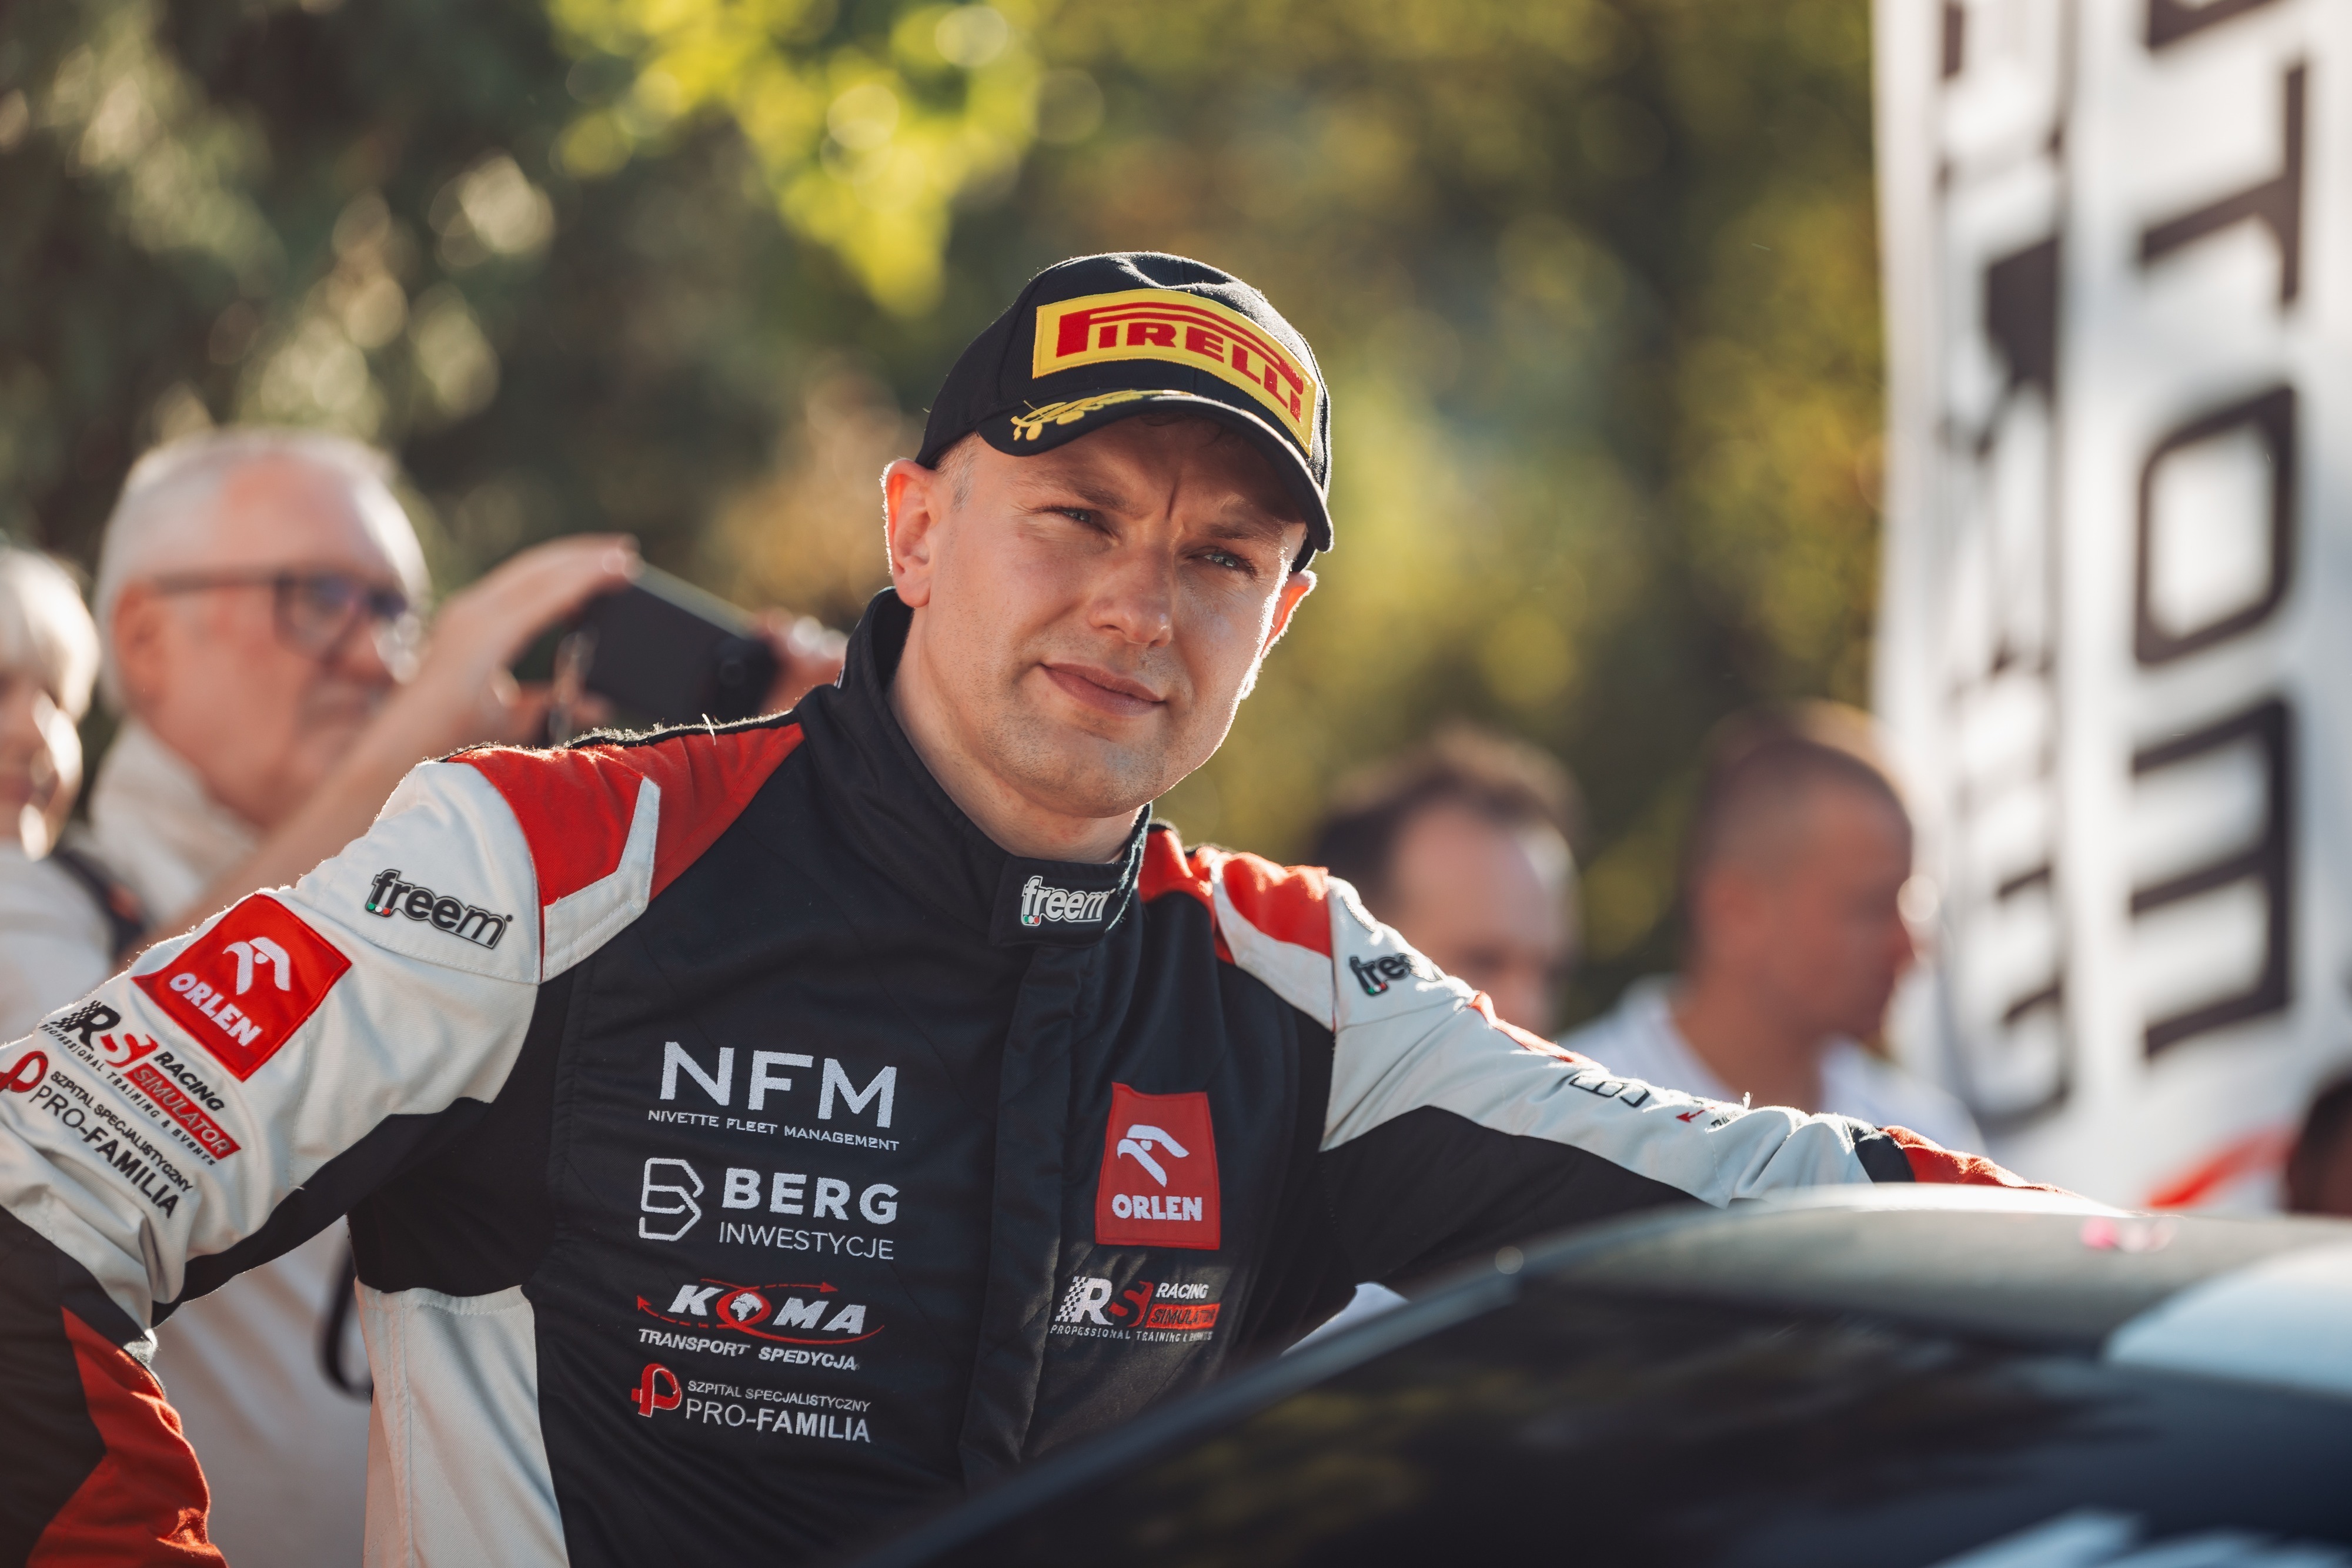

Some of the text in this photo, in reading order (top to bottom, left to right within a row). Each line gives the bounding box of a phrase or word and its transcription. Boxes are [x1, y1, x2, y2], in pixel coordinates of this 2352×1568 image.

[1056, 302, 1304, 423] PIRELLI
[365, 868, 506, 950] freem
[1021, 875, 1110, 927] freem
[169, 972, 263, 1047] ORLEN
[39, 1024, 105, 1072] PROFESSIONAL
[106, 1072, 160, 1118] TRAINING
[172, 1128, 216, 1166] EVENTS
[153, 1051, 225, 1111] RACING
[660, 1041, 897, 1128] NFM
[51, 1071, 193, 1192] SZPITAL SPECJALISTYCZNY
[134, 1069, 230, 1155] SIMULATOR
[648, 1110, 900, 1151] NIVETTE FLEET MANAGEMENT
[29, 1085, 179, 1219] PRO-FAMILIA
[721, 1168, 900, 1224] BERG
[1112, 1193, 1202, 1222] ORLEN
[719, 1221, 894, 1260] INWESTYCJE
[667, 1284, 867, 1335] KOMA
[1155, 1282, 1209, 1300] RACING
[639, 1329, 857, 1371] TRANSPORT SPEDYCJA
[1050, 1324, 1131, 1339] PROFESSIONAL
[1136, 1330, 1181, 1343] TRAINING
[686, 1398, 871, 1443] PRO-FAMILIA
[687, 1380, 871, 1412] SZPITAL SPECJALISTYCZNY
